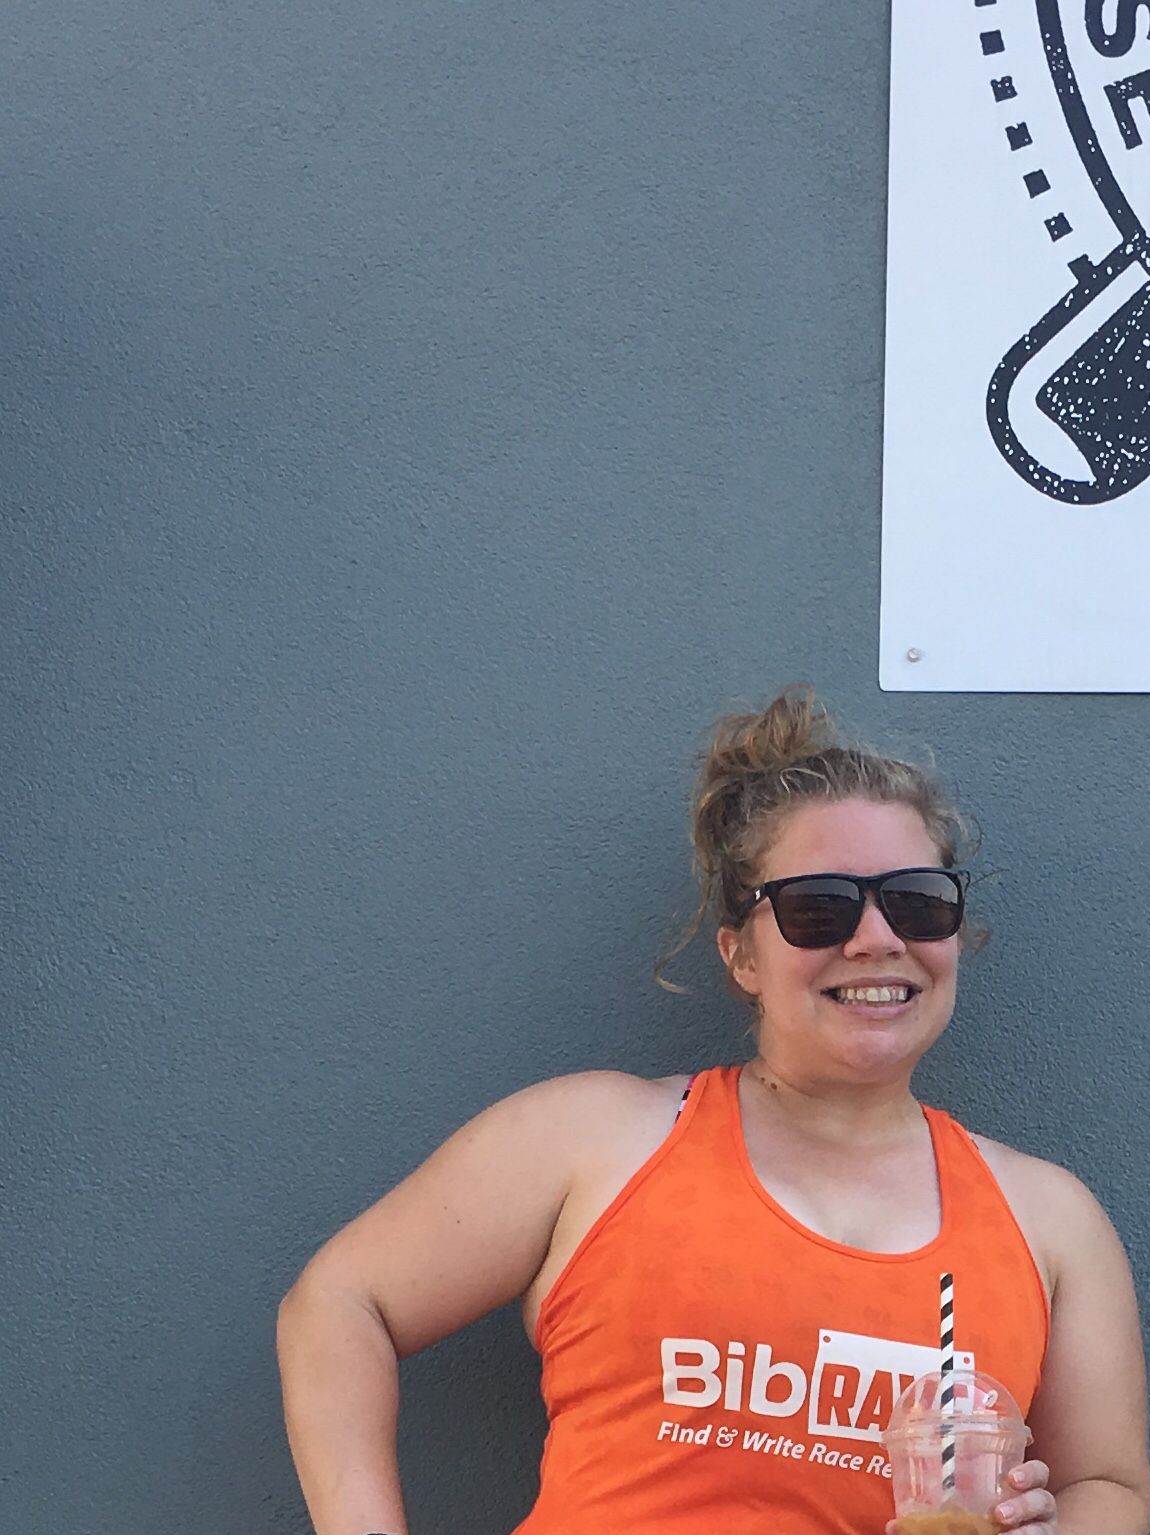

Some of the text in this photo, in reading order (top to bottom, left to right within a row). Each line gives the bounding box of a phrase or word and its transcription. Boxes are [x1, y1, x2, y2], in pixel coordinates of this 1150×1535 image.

[657, 1421, 712, 1446] Find
[715, 1426, 739, 1448] &
[743, 1430, 806, 1460] Write
[808, 1443, 864, 1471] Race
